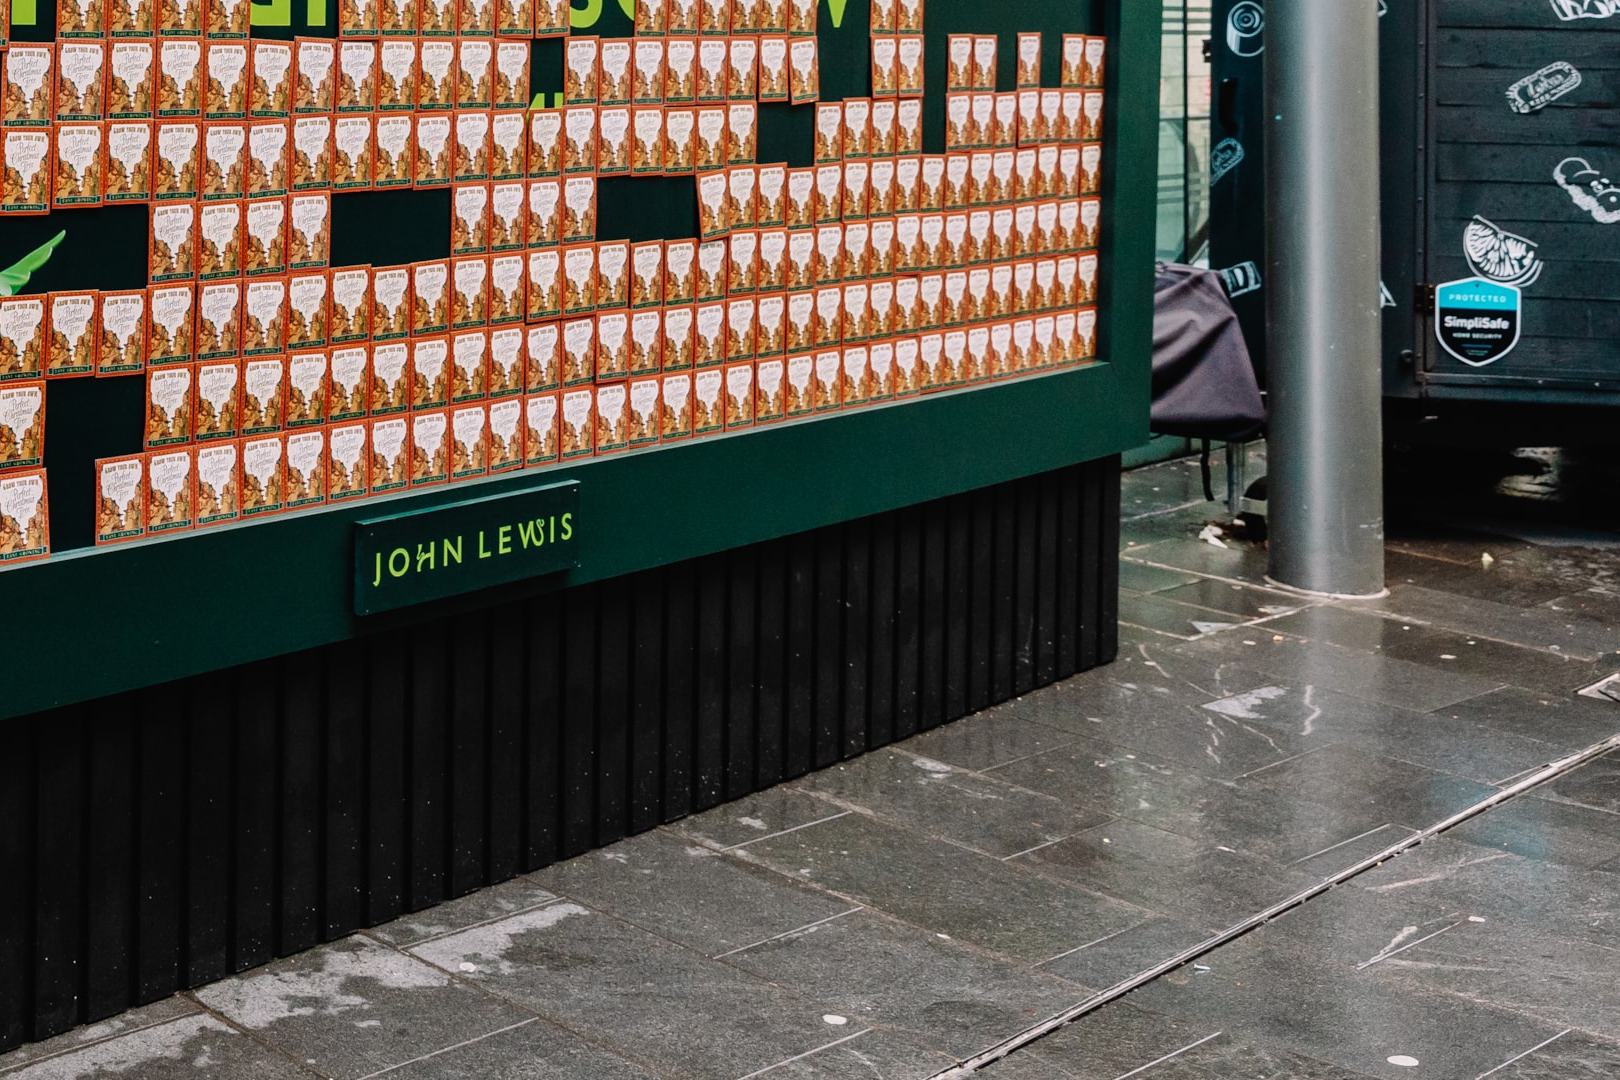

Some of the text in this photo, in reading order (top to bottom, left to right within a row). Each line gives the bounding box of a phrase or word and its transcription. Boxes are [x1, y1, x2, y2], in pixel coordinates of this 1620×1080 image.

[1449, 293, 1507, 303] PROTECTED
[1443, 315, 1510, 330] SimpliSafe
[373, 512, 572, 587] JOHN LEWIS
